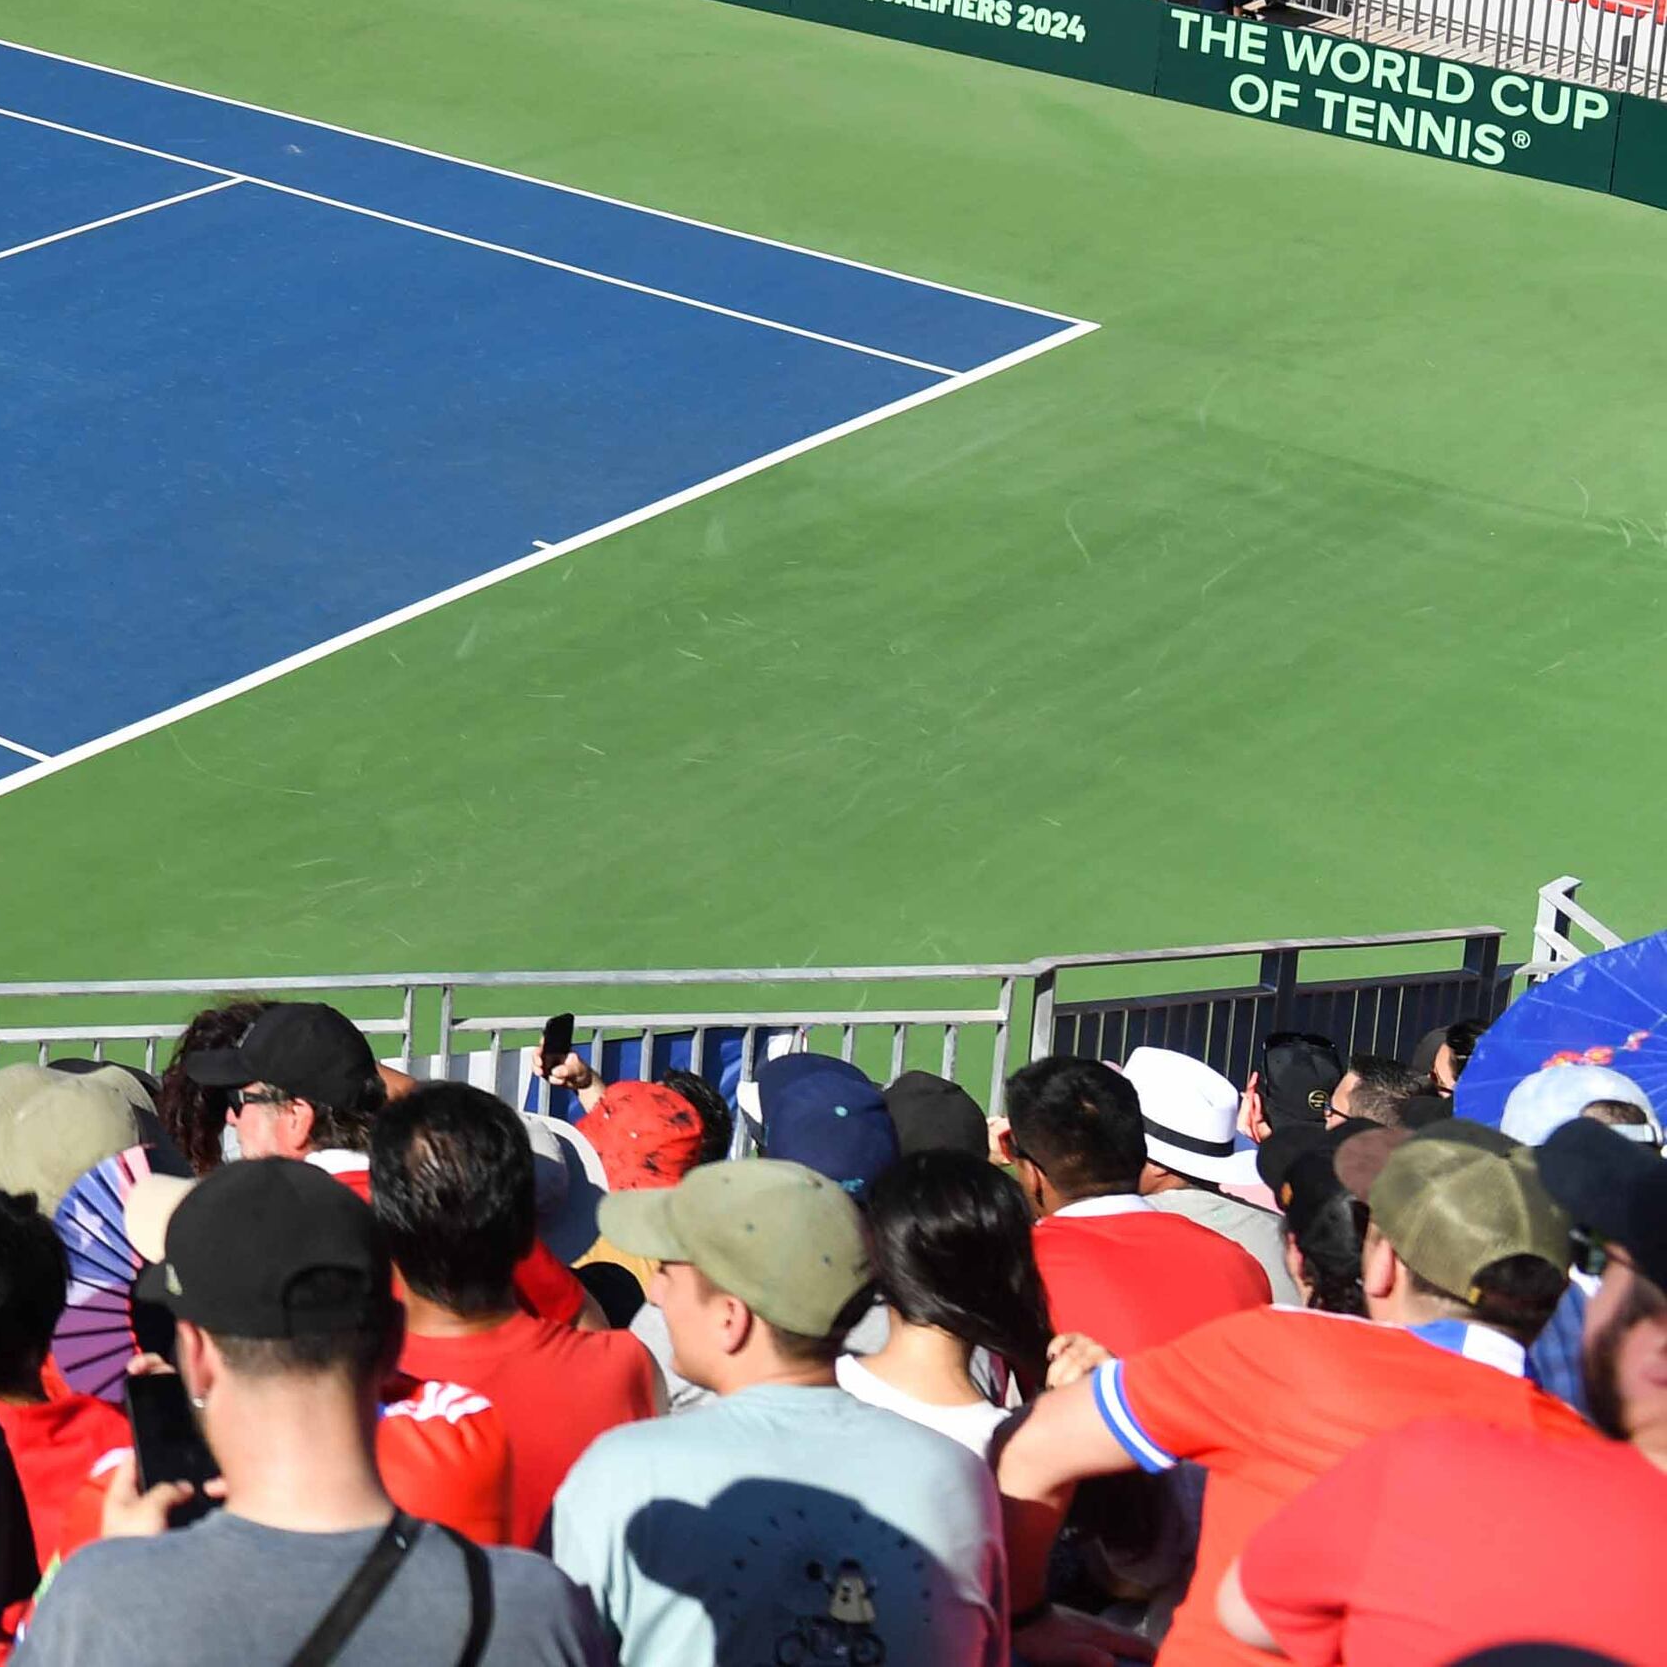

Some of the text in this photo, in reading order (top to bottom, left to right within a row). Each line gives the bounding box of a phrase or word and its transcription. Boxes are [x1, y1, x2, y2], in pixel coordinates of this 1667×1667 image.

[1016, 4, 1086, 43] 2024
[1171, 9, 1609, 130] THE WORLD CUP
[1230, 74, 1300, 119] OF
